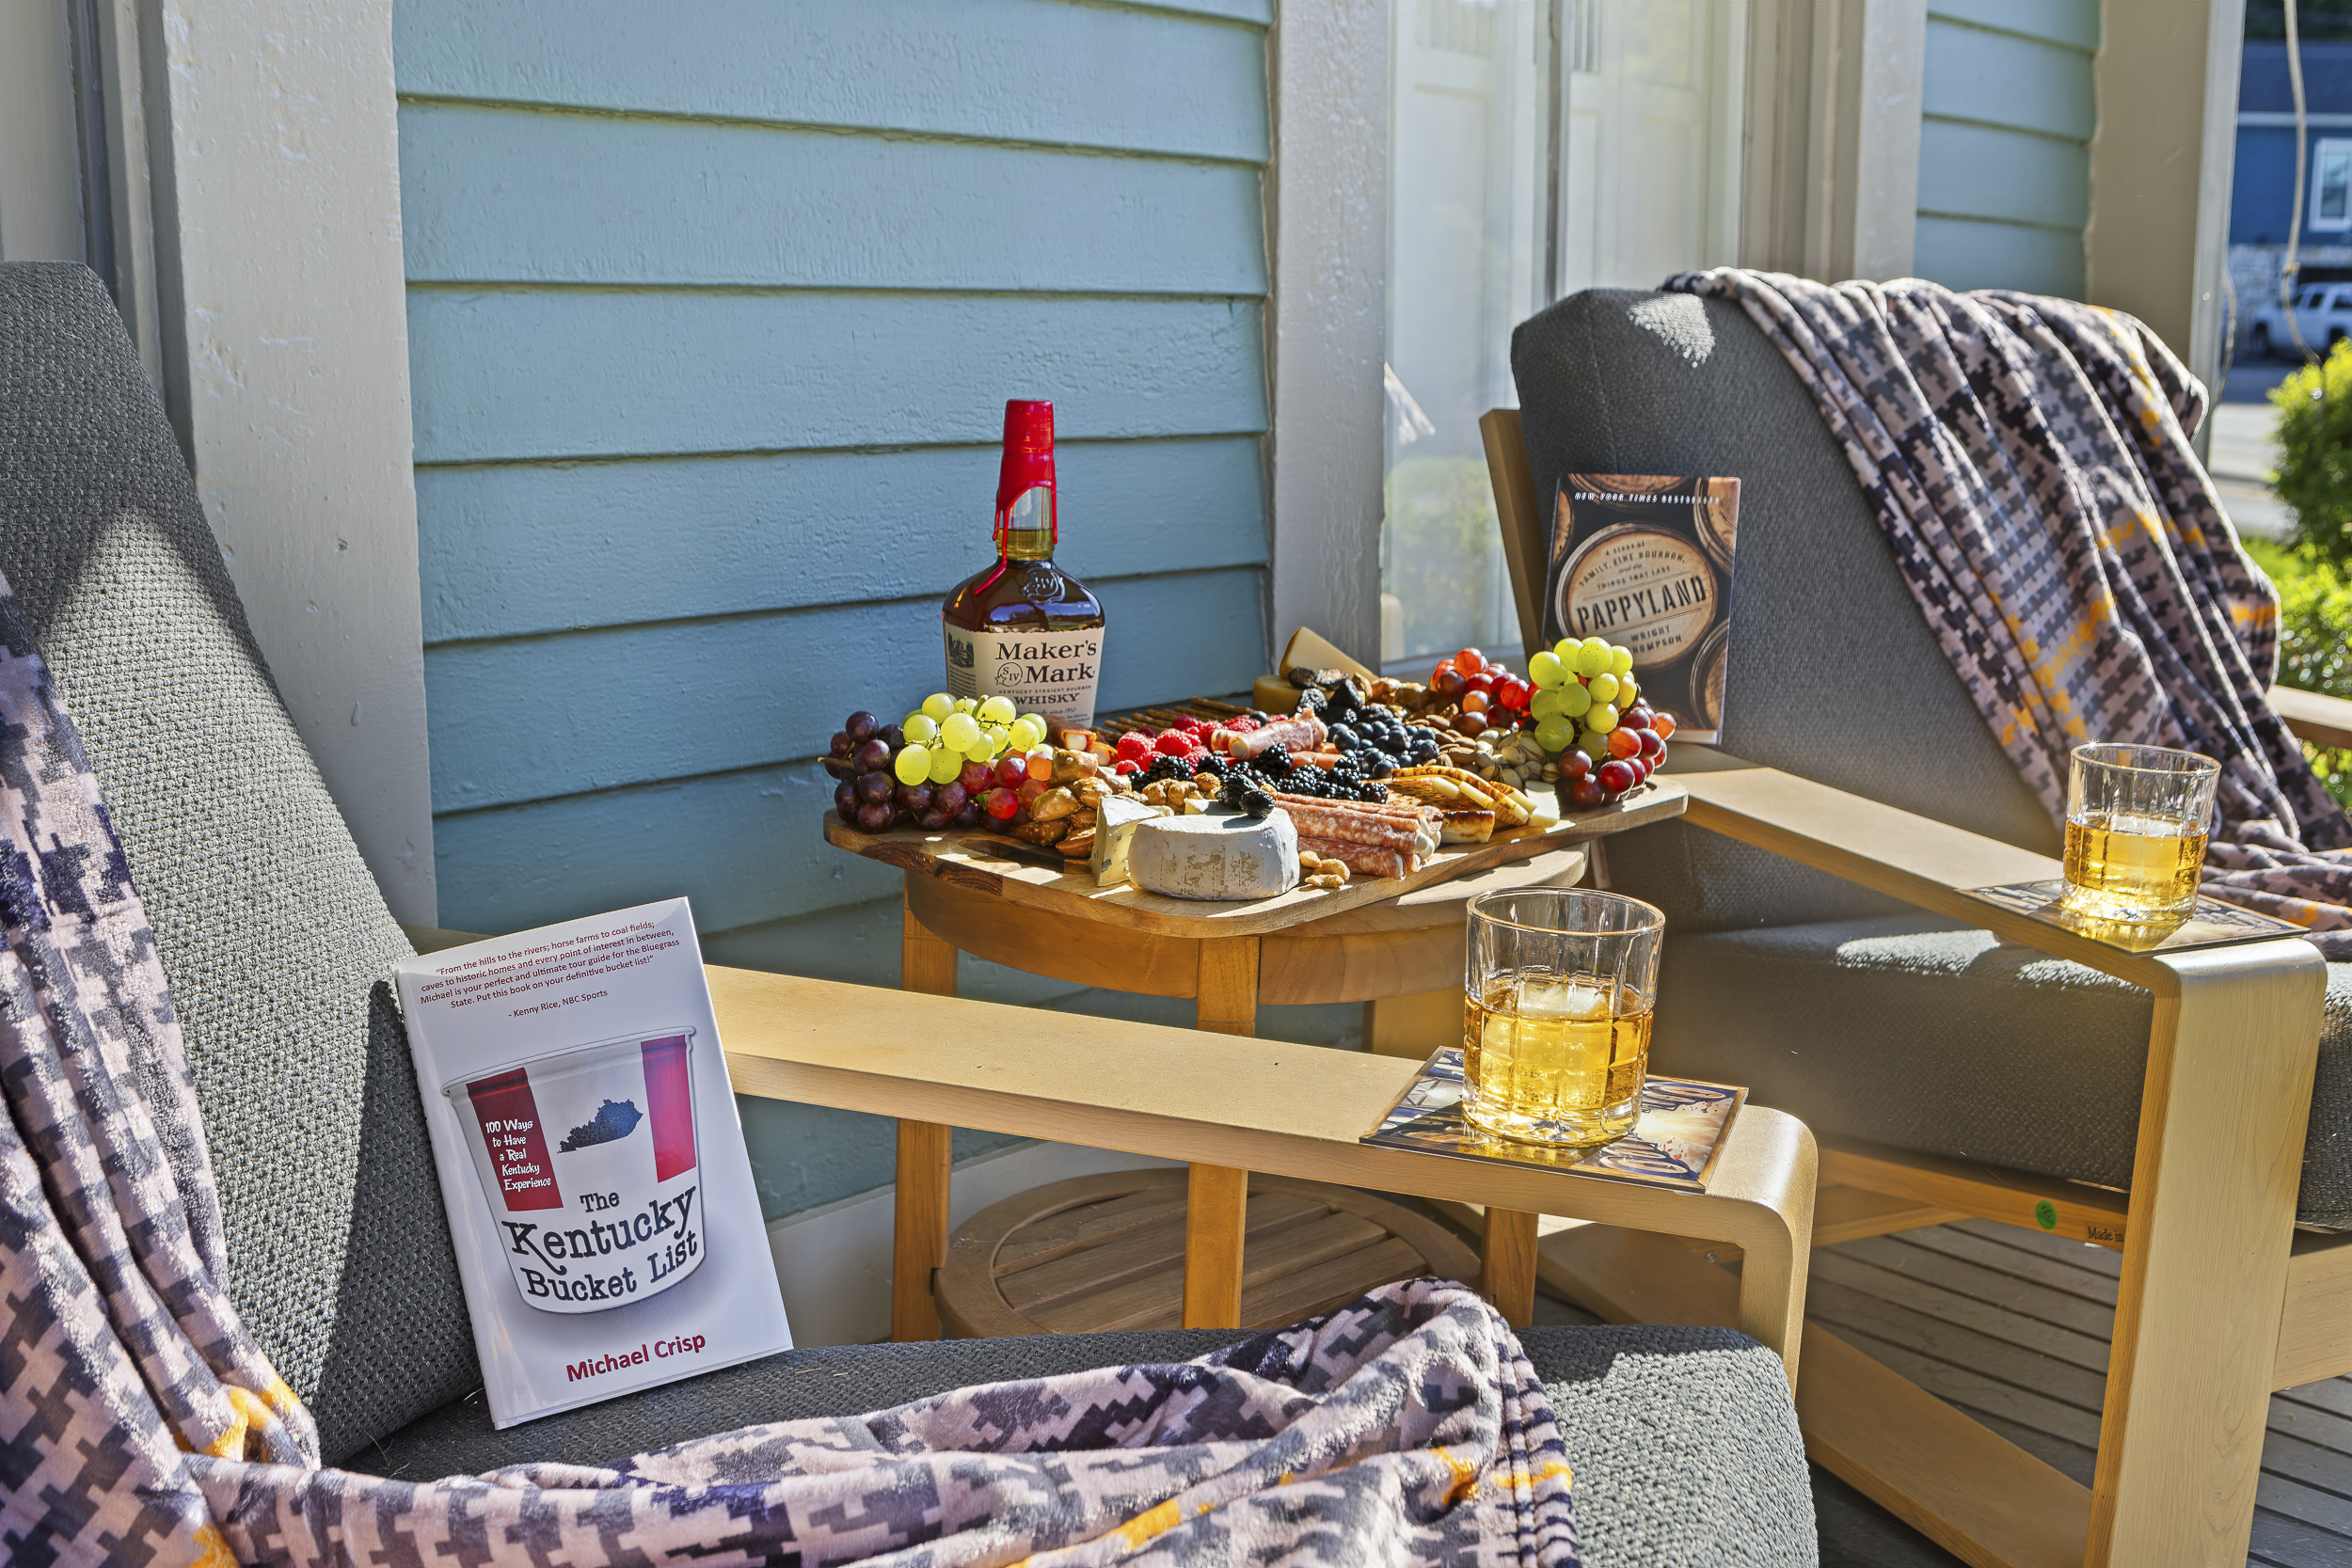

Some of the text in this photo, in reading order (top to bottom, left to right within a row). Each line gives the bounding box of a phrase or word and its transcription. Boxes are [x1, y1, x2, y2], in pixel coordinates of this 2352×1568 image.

[1613, 553, 1634, 565] FINE
[1639, 549, 1685, 564] BOURBON,
[1577, 575, 1707, 633] PAPPYLAND
[1630, 625, 1671, 641] WRIGHT
[1632, 634, 1682, 654] HOMPSON
[994, 639, 1097, 660] Maker's
[1023, 662, 1094, 684] Mark
[1013, 692, 1081, 705] WHISKY
[463, 961, 478, 970] the
[479, 956, 497, 966] hills
[508, 950, 523, 959] the
[524, 944, 550, 956] rivers;
[551, 939, 575, 950] horse
[576, 933, 600, 944] farms
[612, 926, 628, 935] coal
[629, 921, 655, 932] fields;
[421, 982, 444, 991] caves
[455, 971, 487, 984] historic
[488, 964, 516, 976] homes
[517, 959, 533, 969] and
[534, 954, 558, 965] every
[559, 949, 581, 959] point
[583, 944, 592, 954] of
[593, 941, 626, 952] interest
[635, 929, 675, 942] between,
[420, 990, 453, 1005] Michael
[463, 984, 482, 995] your
[484, 976, 514, 990] perfect
[515, 971, 531, 981] and
[532, 963, 567, 977] ultimate
[568, 959, 586, 969] tour
[588, 954, 612, 967] guide
[612, 950, 625, 959] for
[626, 947, 641, 956] the
[641, 939, 680, 952] Bluegrass
[450, 998, 475, 1008] State.
[476, 993, 491, 1003] Put
[493, 989, 508, 999] this
[510, 984, 531, 994] book
[545, 976, 564, 988] your
[565, 967, 604, 982] definitive
[606, 959, 634, 973] bucket
[513, 1006, 539, 1018] Kenny
[540, 1001, 561, 1010] Rice,
[563, 995, 580, 1006] NBC
[581, 990, 608, 1003] Sports
[485, 1118, 533, 1134] 100 Ways
[492, 1134, 527, 1148] to Have
[499, 1148, 528, 1162] a Real
[501, 1163, 540, 1177] Kentucky
[503, 1177, 551, 1193] Experience
[580, 1191, 621, 1213] The
[501, 1185, 697, 1275] Kentucky
[519, 1230, 699, 1302] Bucket List
[565, 1332, 707, 1383] Michael Crisp
